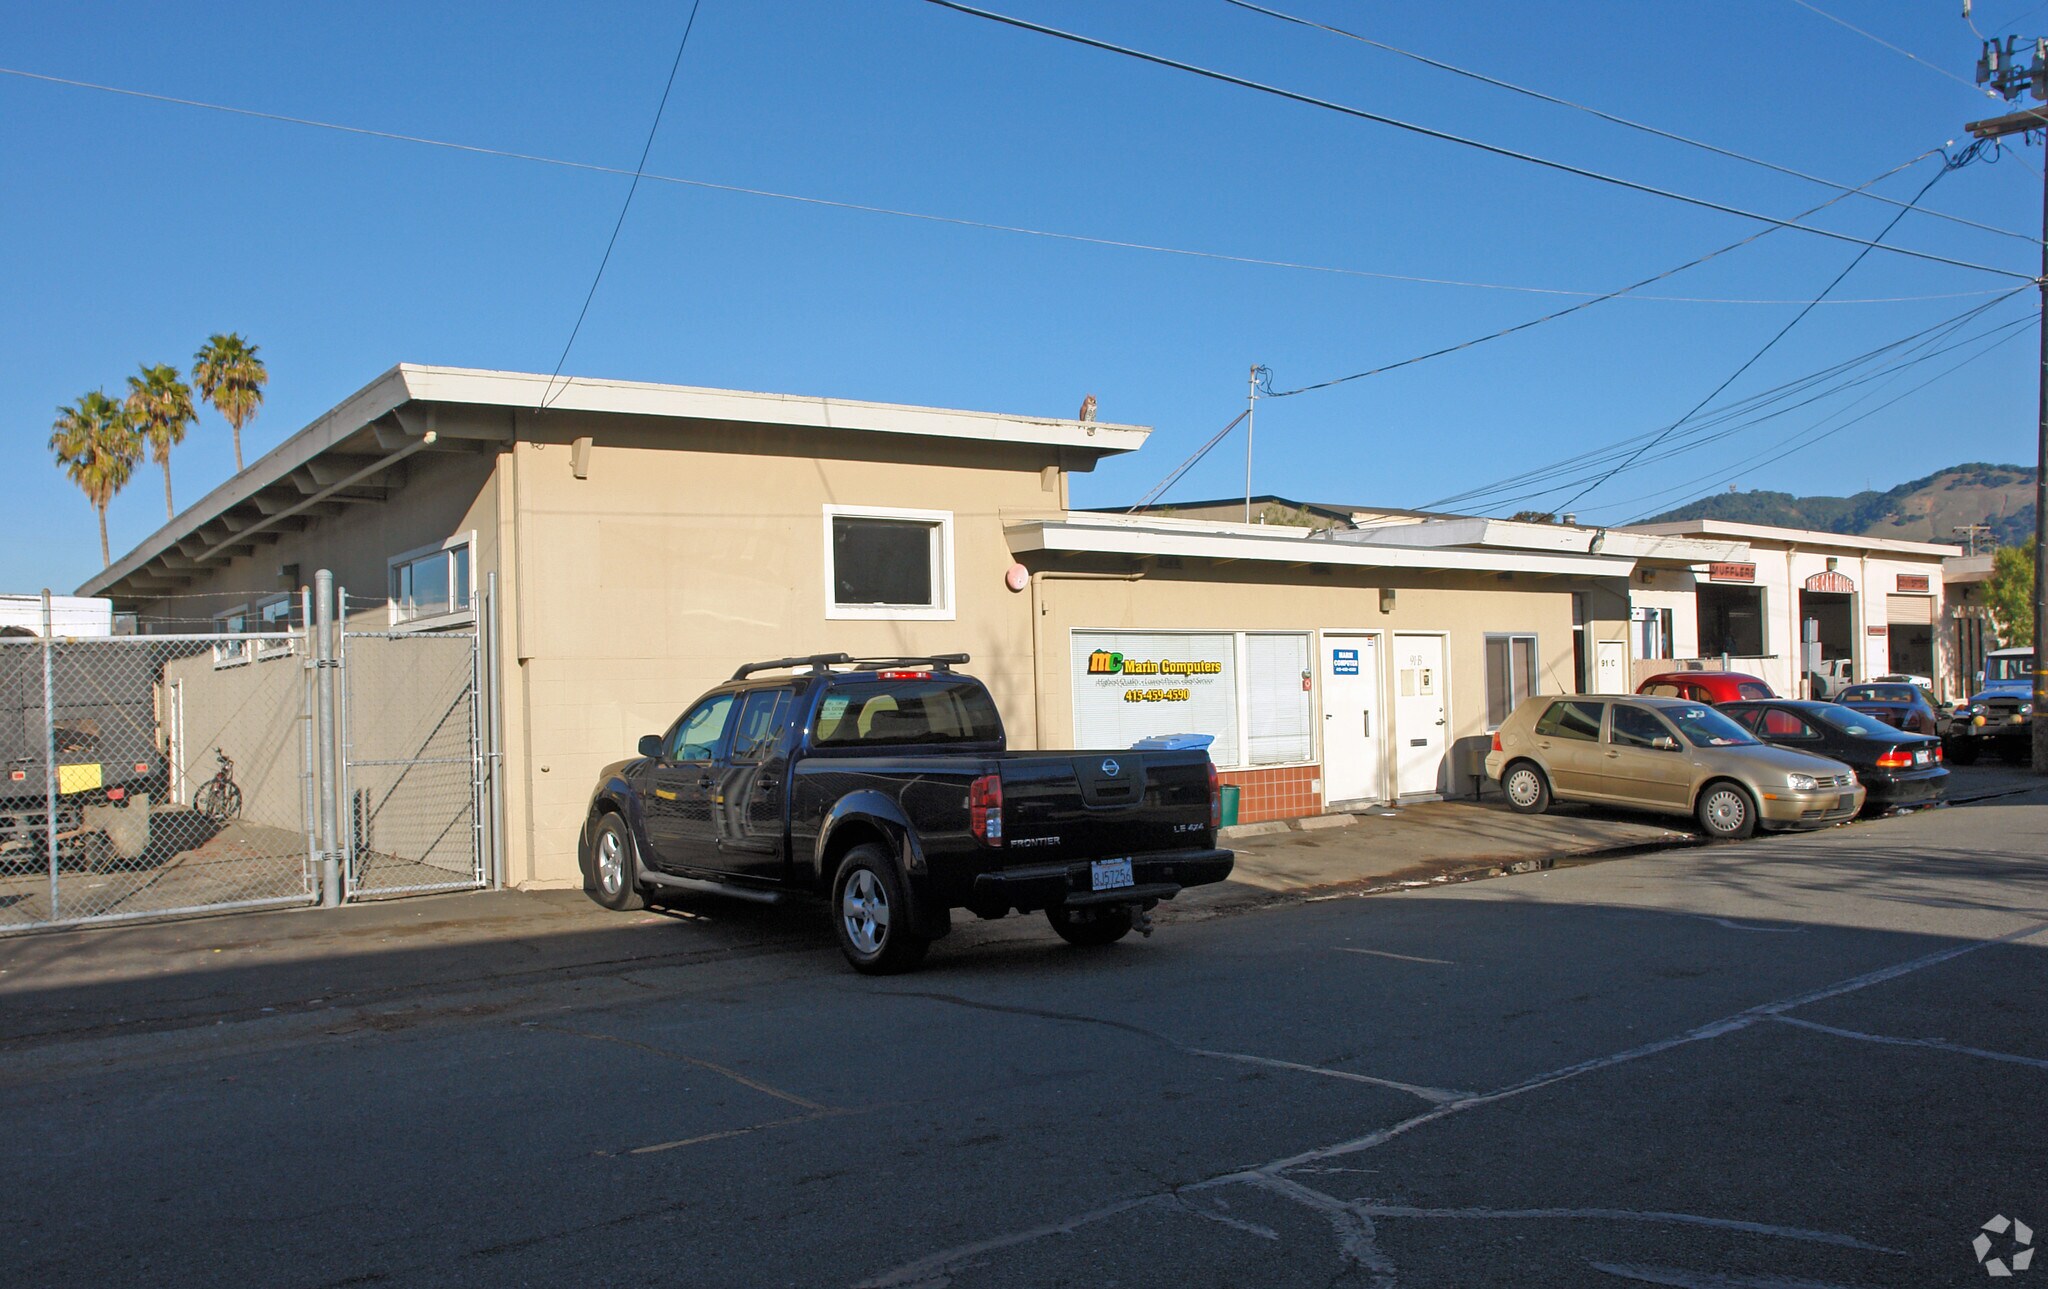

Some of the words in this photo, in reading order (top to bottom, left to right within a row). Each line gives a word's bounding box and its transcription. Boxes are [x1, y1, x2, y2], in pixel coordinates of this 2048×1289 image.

[1711, 565, 1754, 578] MUFFLERS
[1123, 659, 1158, 675] Marin
[1160, 658, 1222, 677] Computers
[1124, 688, 1191, 703] 415-459-4590
[1173, 824, 1187, 833] LE
[1010, 836, 1061, 848] FRONTIER
[1093, 868, 1132, 887] 8J57256
